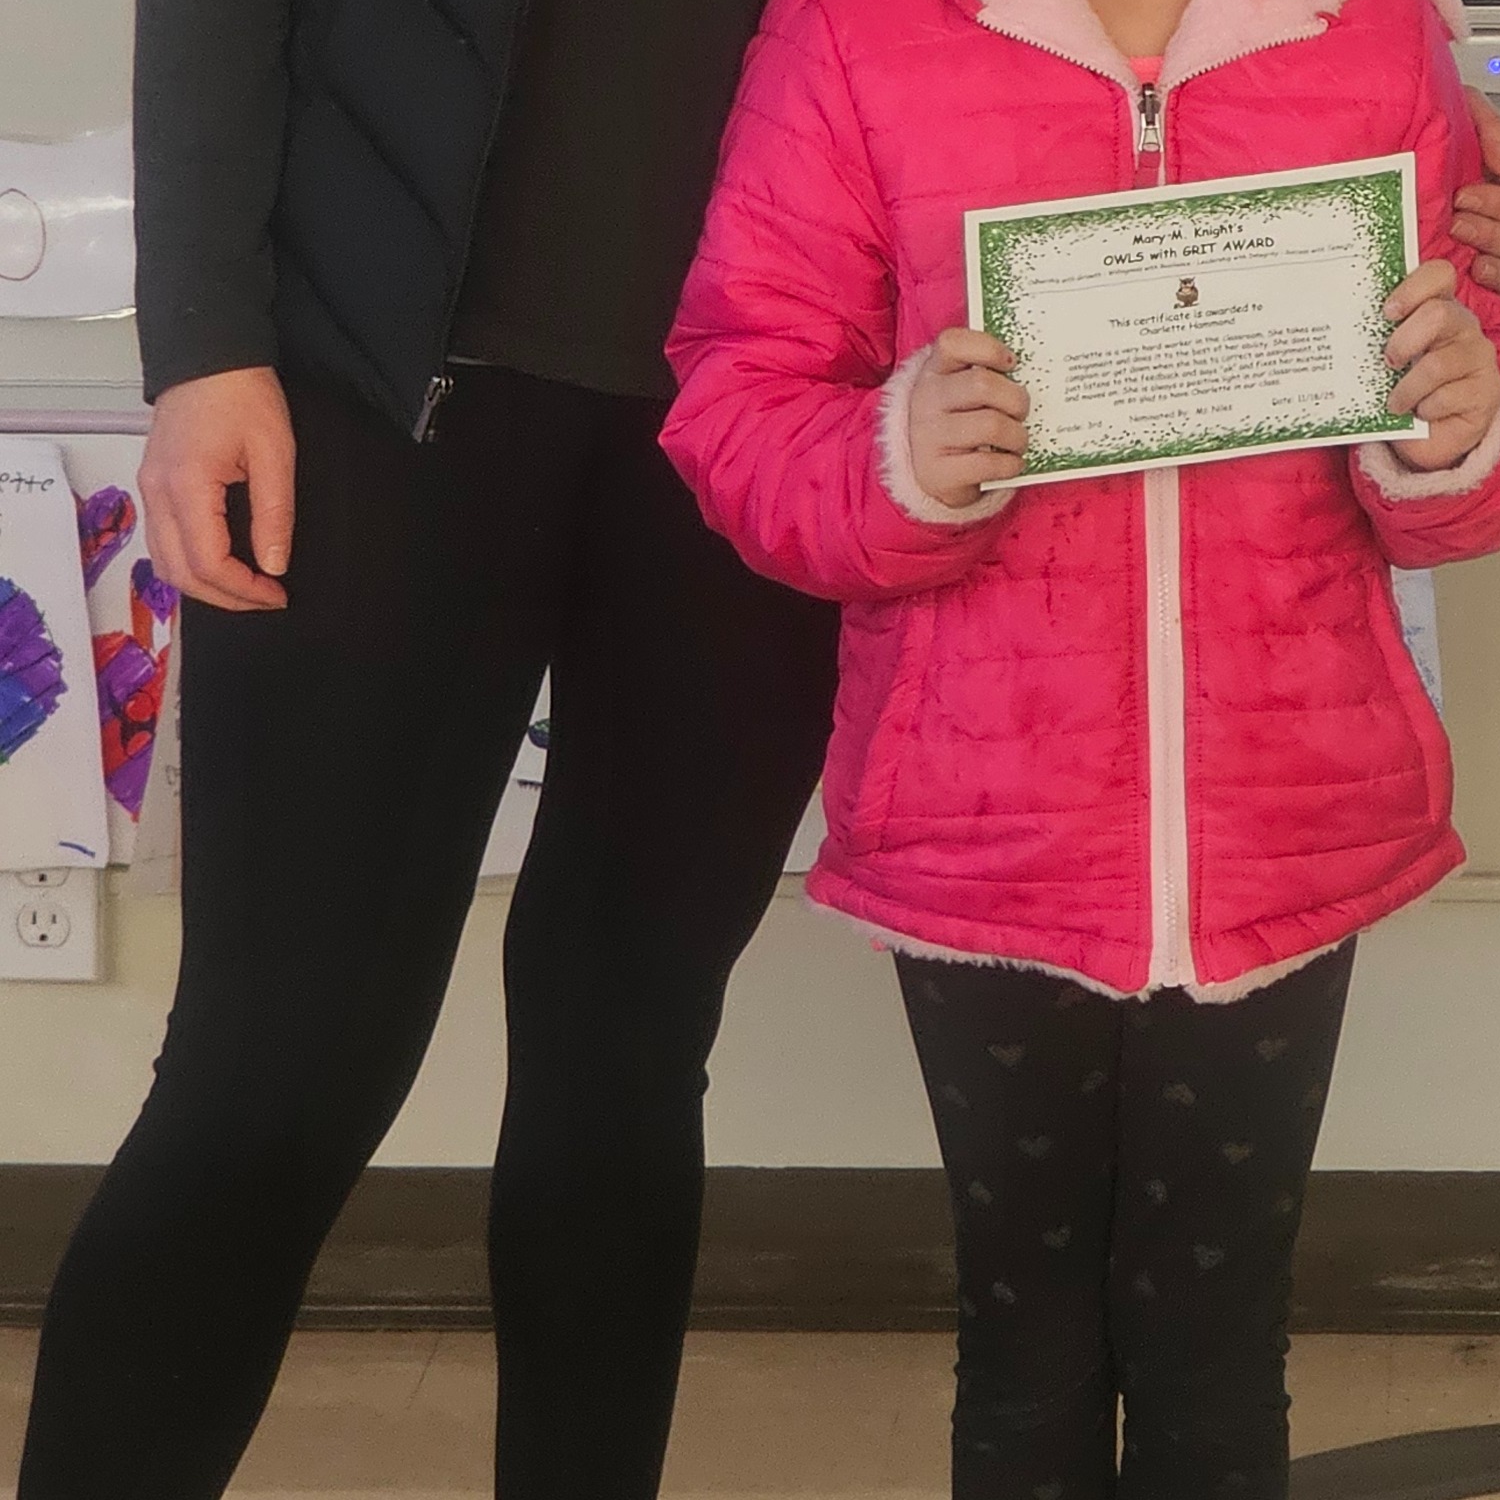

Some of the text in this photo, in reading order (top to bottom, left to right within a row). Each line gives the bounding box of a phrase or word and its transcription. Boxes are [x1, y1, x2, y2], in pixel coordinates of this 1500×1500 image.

[1133, 233, 1166, 246] Mary
[1103, 236, 1275, 267] OWLS with GRIT AWARD
